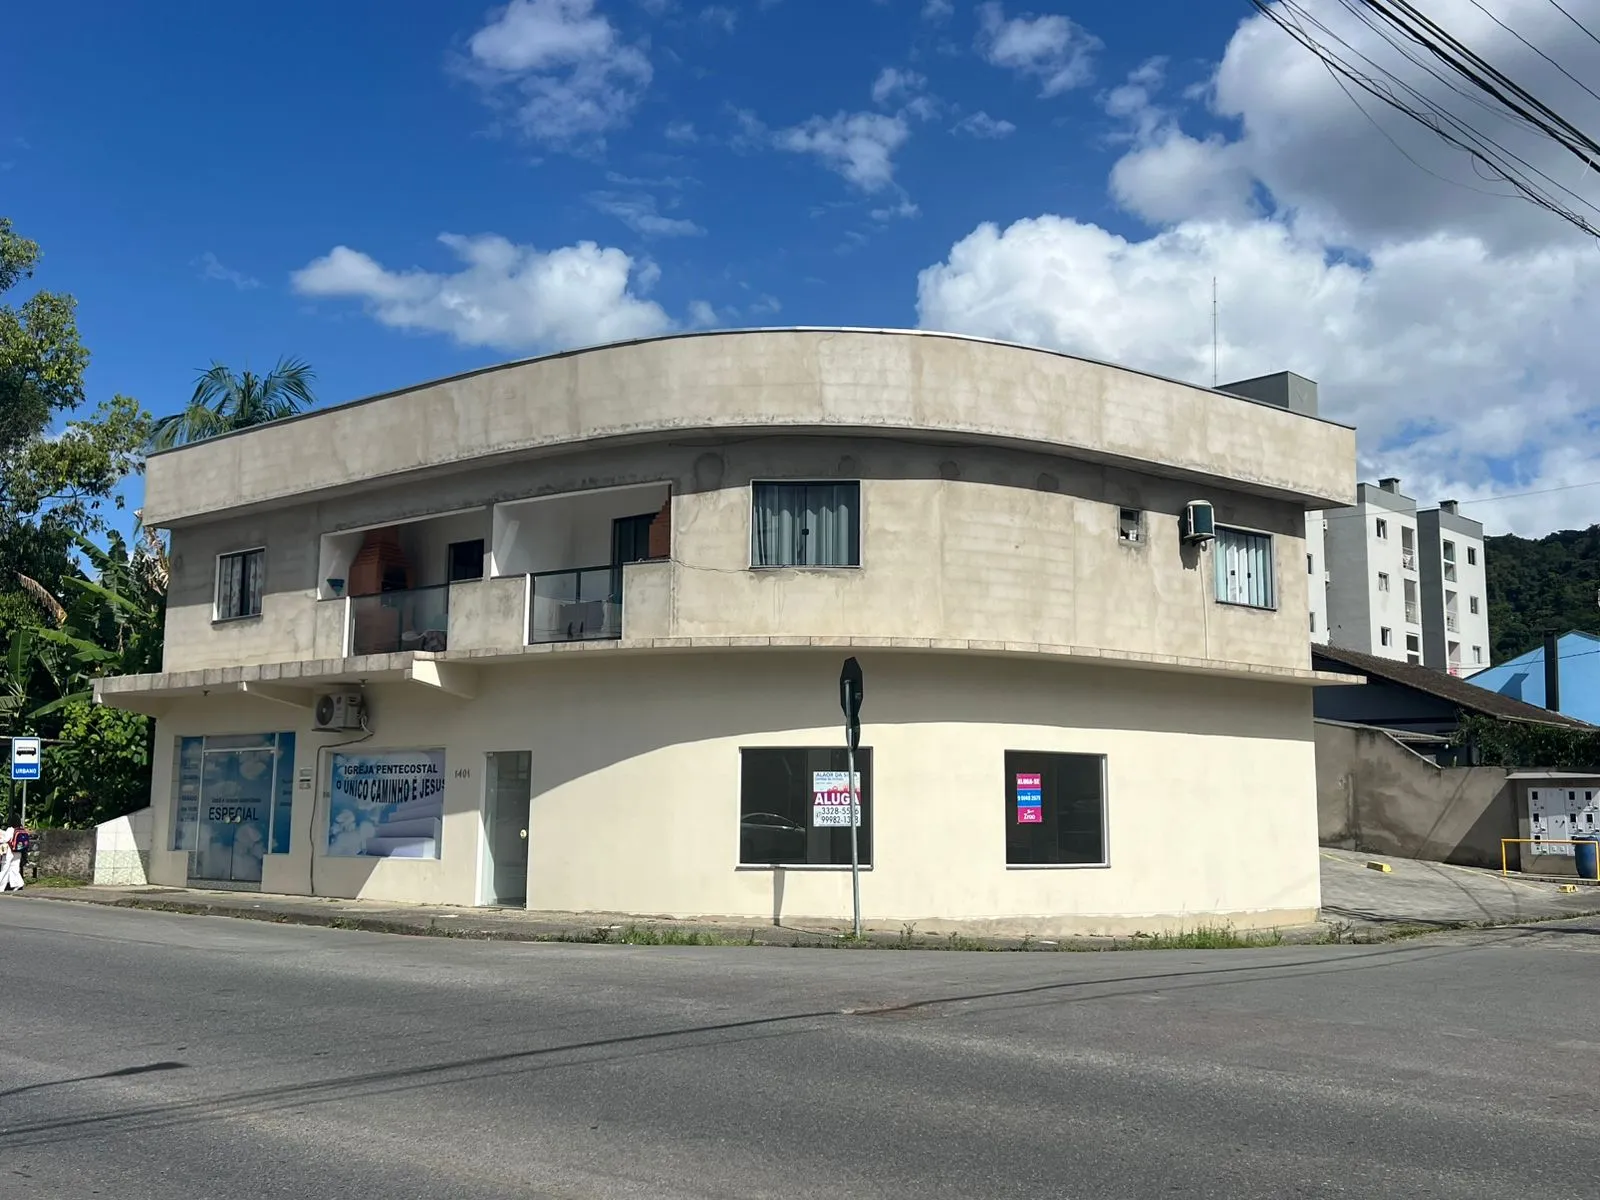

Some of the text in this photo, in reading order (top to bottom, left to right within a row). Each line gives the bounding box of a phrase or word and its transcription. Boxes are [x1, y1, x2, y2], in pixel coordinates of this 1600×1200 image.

[344, 764, 438, 775] IGREJA PENTECOSTAL
[454, 768, 471, 778] 1401
[336, 780, 342, 789] O
[343, 777, 369, 801] ÚNICO
[371, 779, 410, 803] CAMINHO
[209, 807, 259, 821] ESPECIAL
[821, 807, 859, 815] 3328-556
